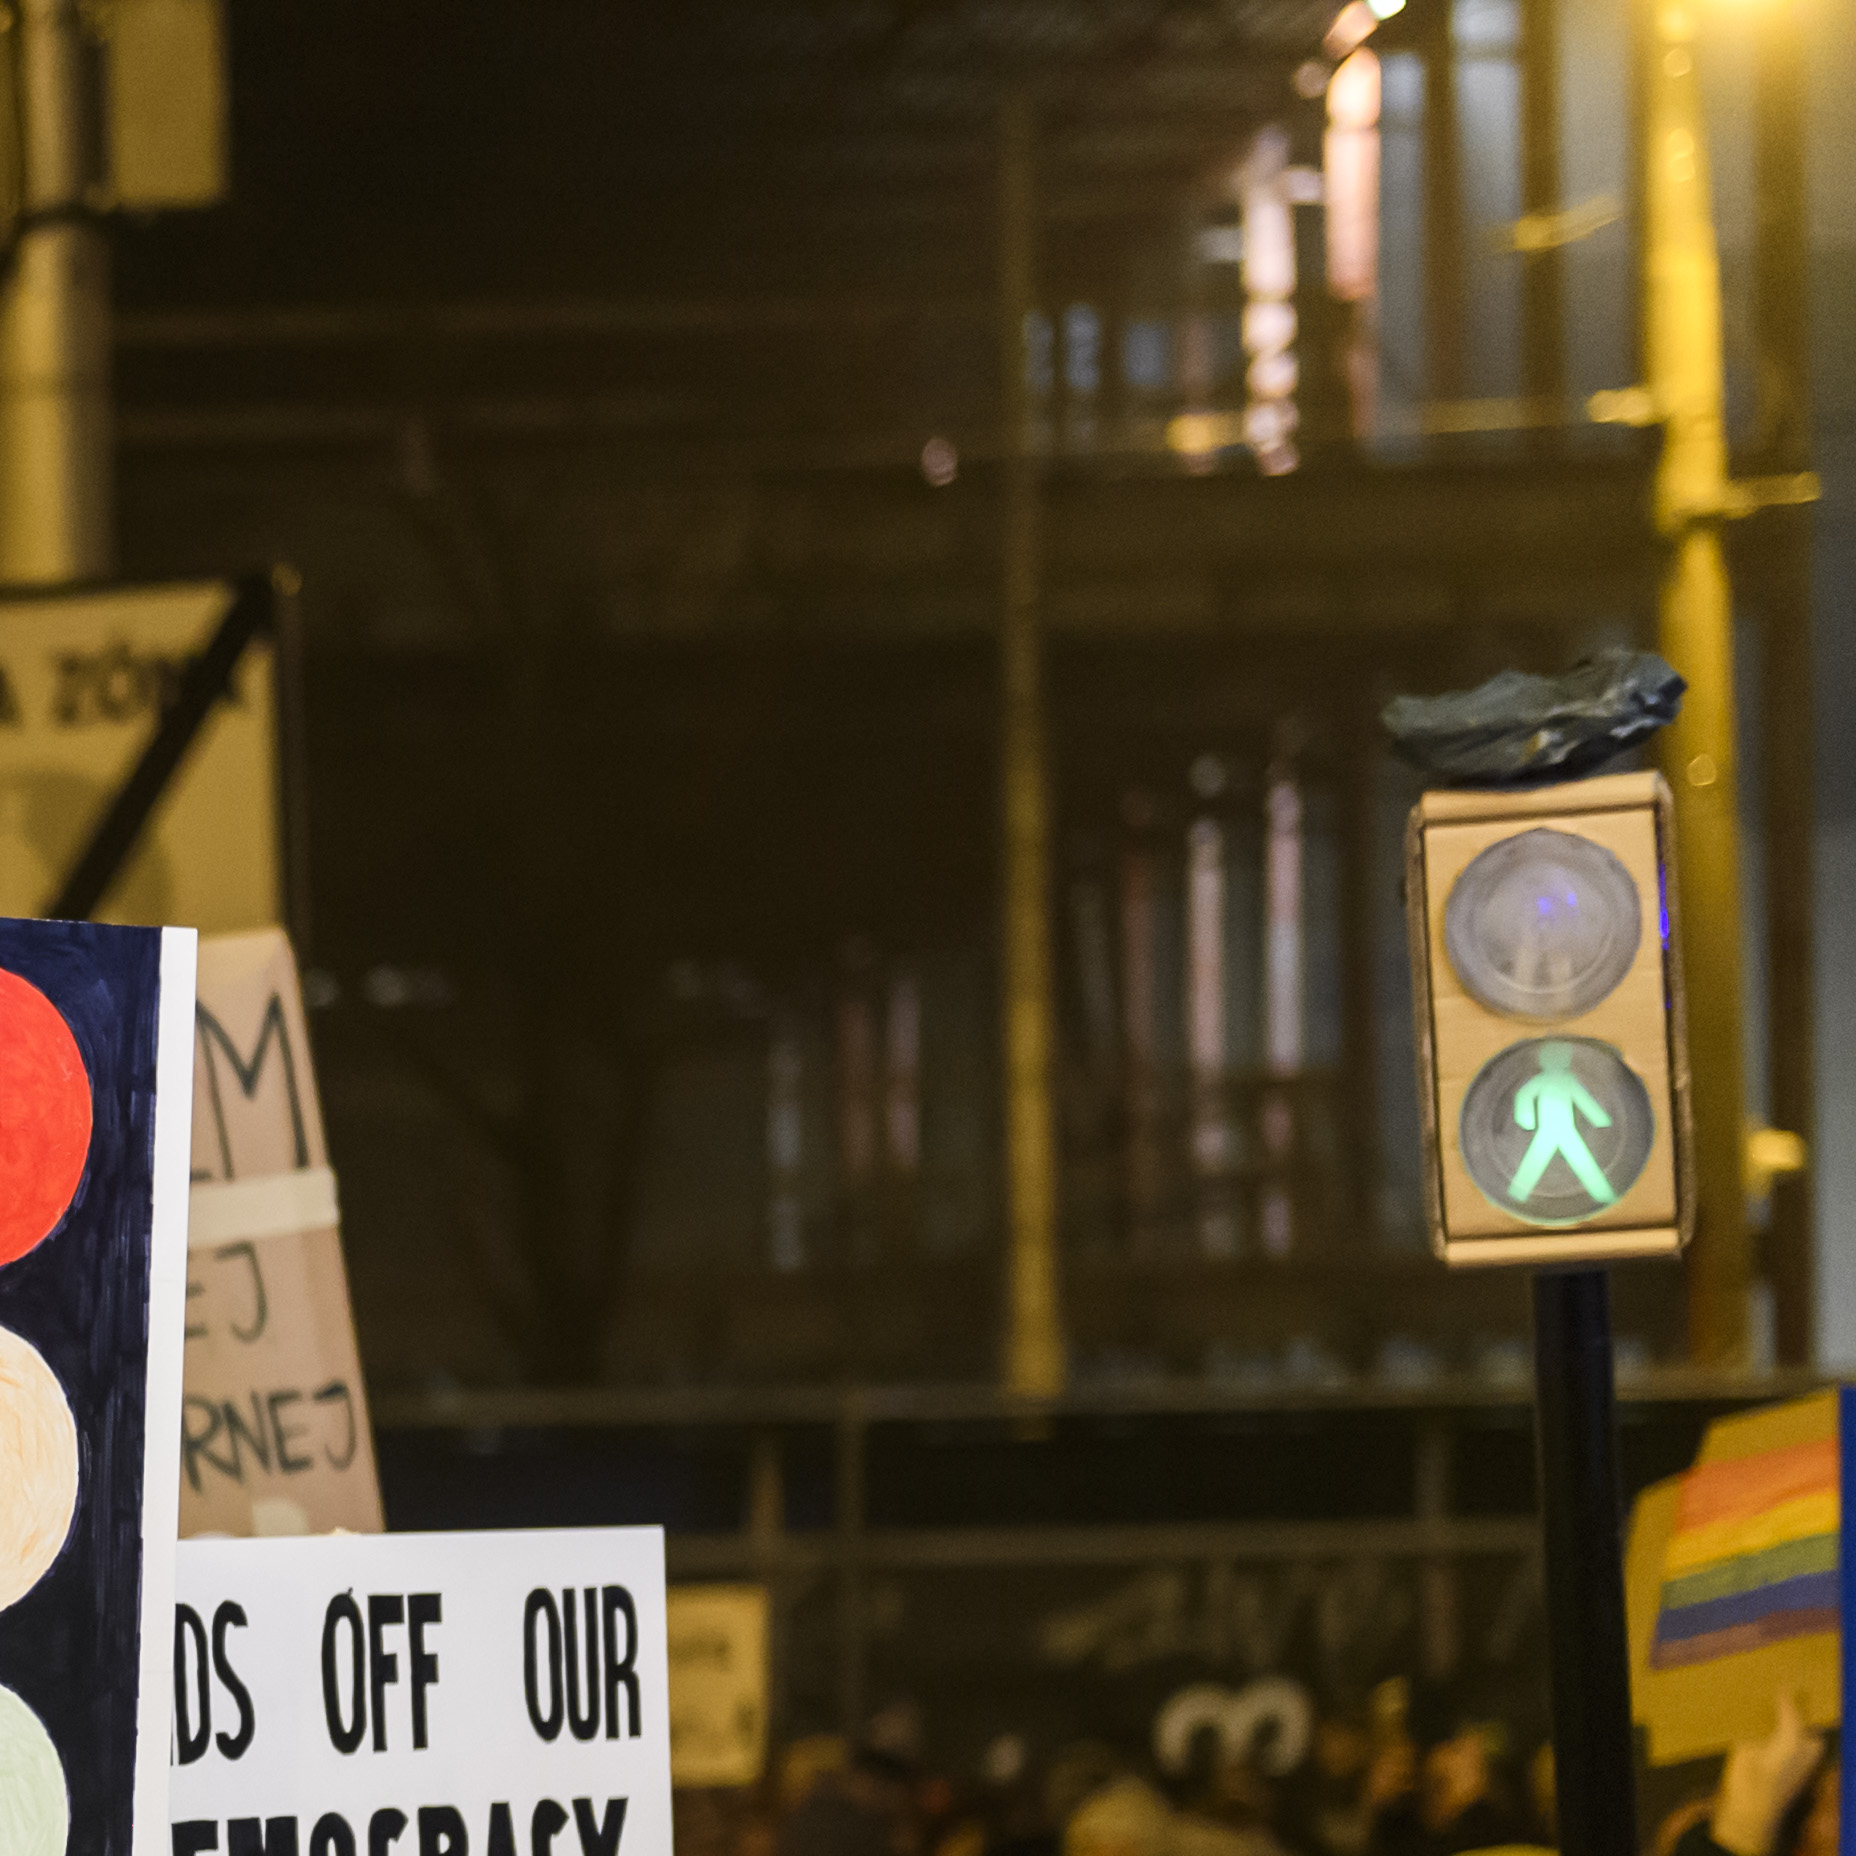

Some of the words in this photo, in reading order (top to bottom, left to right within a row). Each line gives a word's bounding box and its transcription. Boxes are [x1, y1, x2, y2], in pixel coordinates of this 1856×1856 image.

[183, 1377, 356, 1494] RNEJ
[171, 1599, 255, 1766] DS
[321, 1588, 443, 1755] OFF
[523, 1584, 641, 1743] OUR
